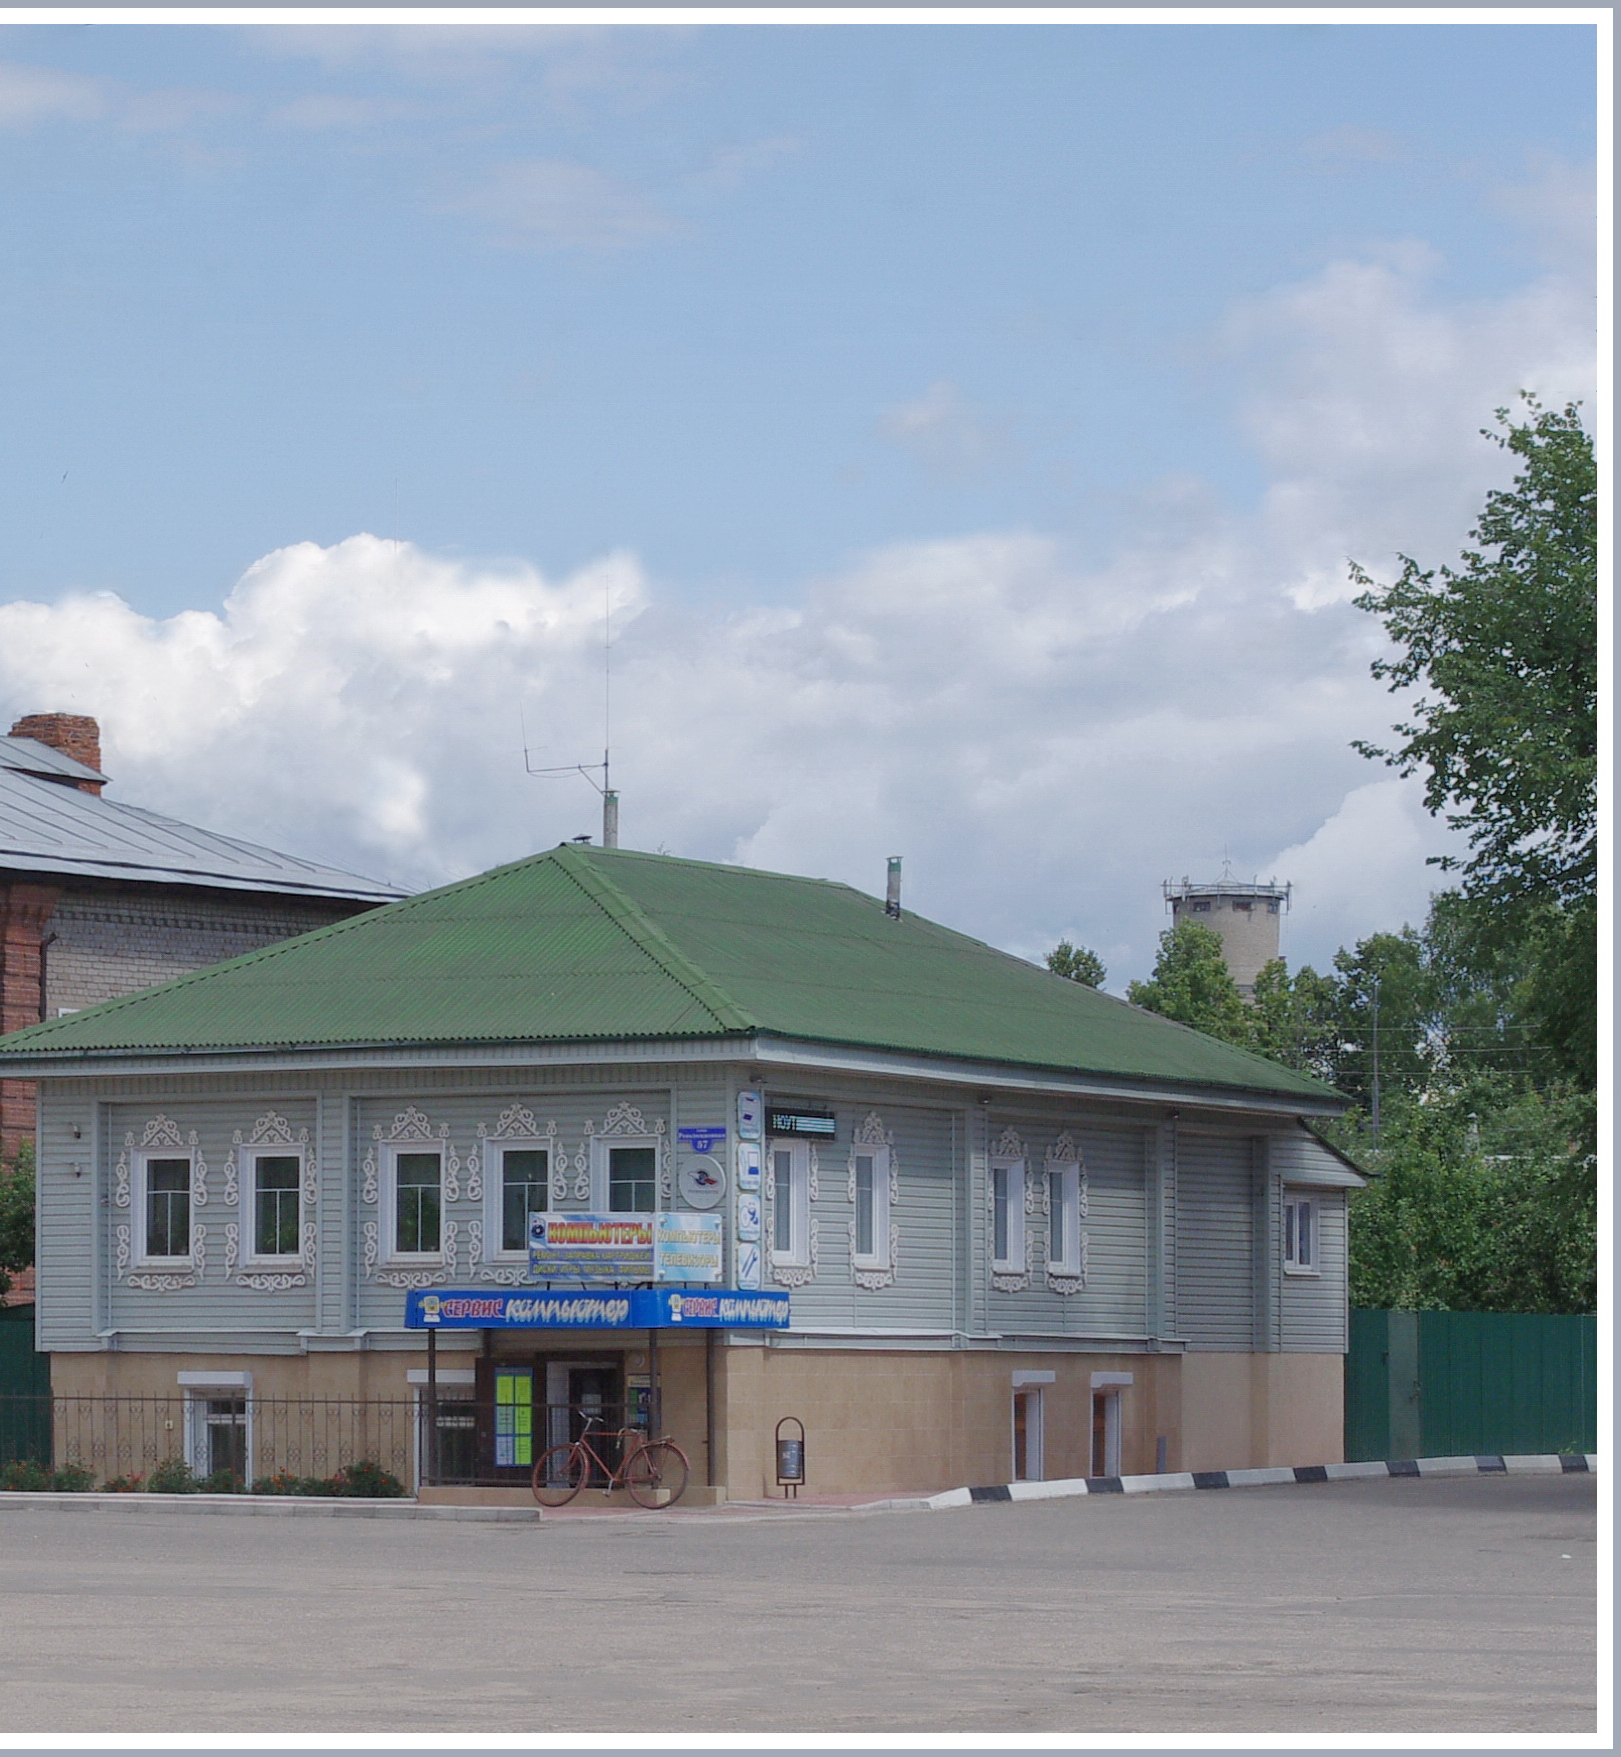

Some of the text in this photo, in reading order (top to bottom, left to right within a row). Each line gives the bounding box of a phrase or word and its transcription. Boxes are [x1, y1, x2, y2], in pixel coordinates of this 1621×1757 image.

[547, 1221, 652, 1244] КОМПЬЮТЕРЫ
[657, 1229, 721, 1245] КОМПЬЮТЕРЫ
[660, 1252, 719, 1268] ТЕЛЕВИЗОРЫ
[443, 1298, 503, 1318] СЕРВИС
[683, 1297, 718, 1318] СЕРВИС
